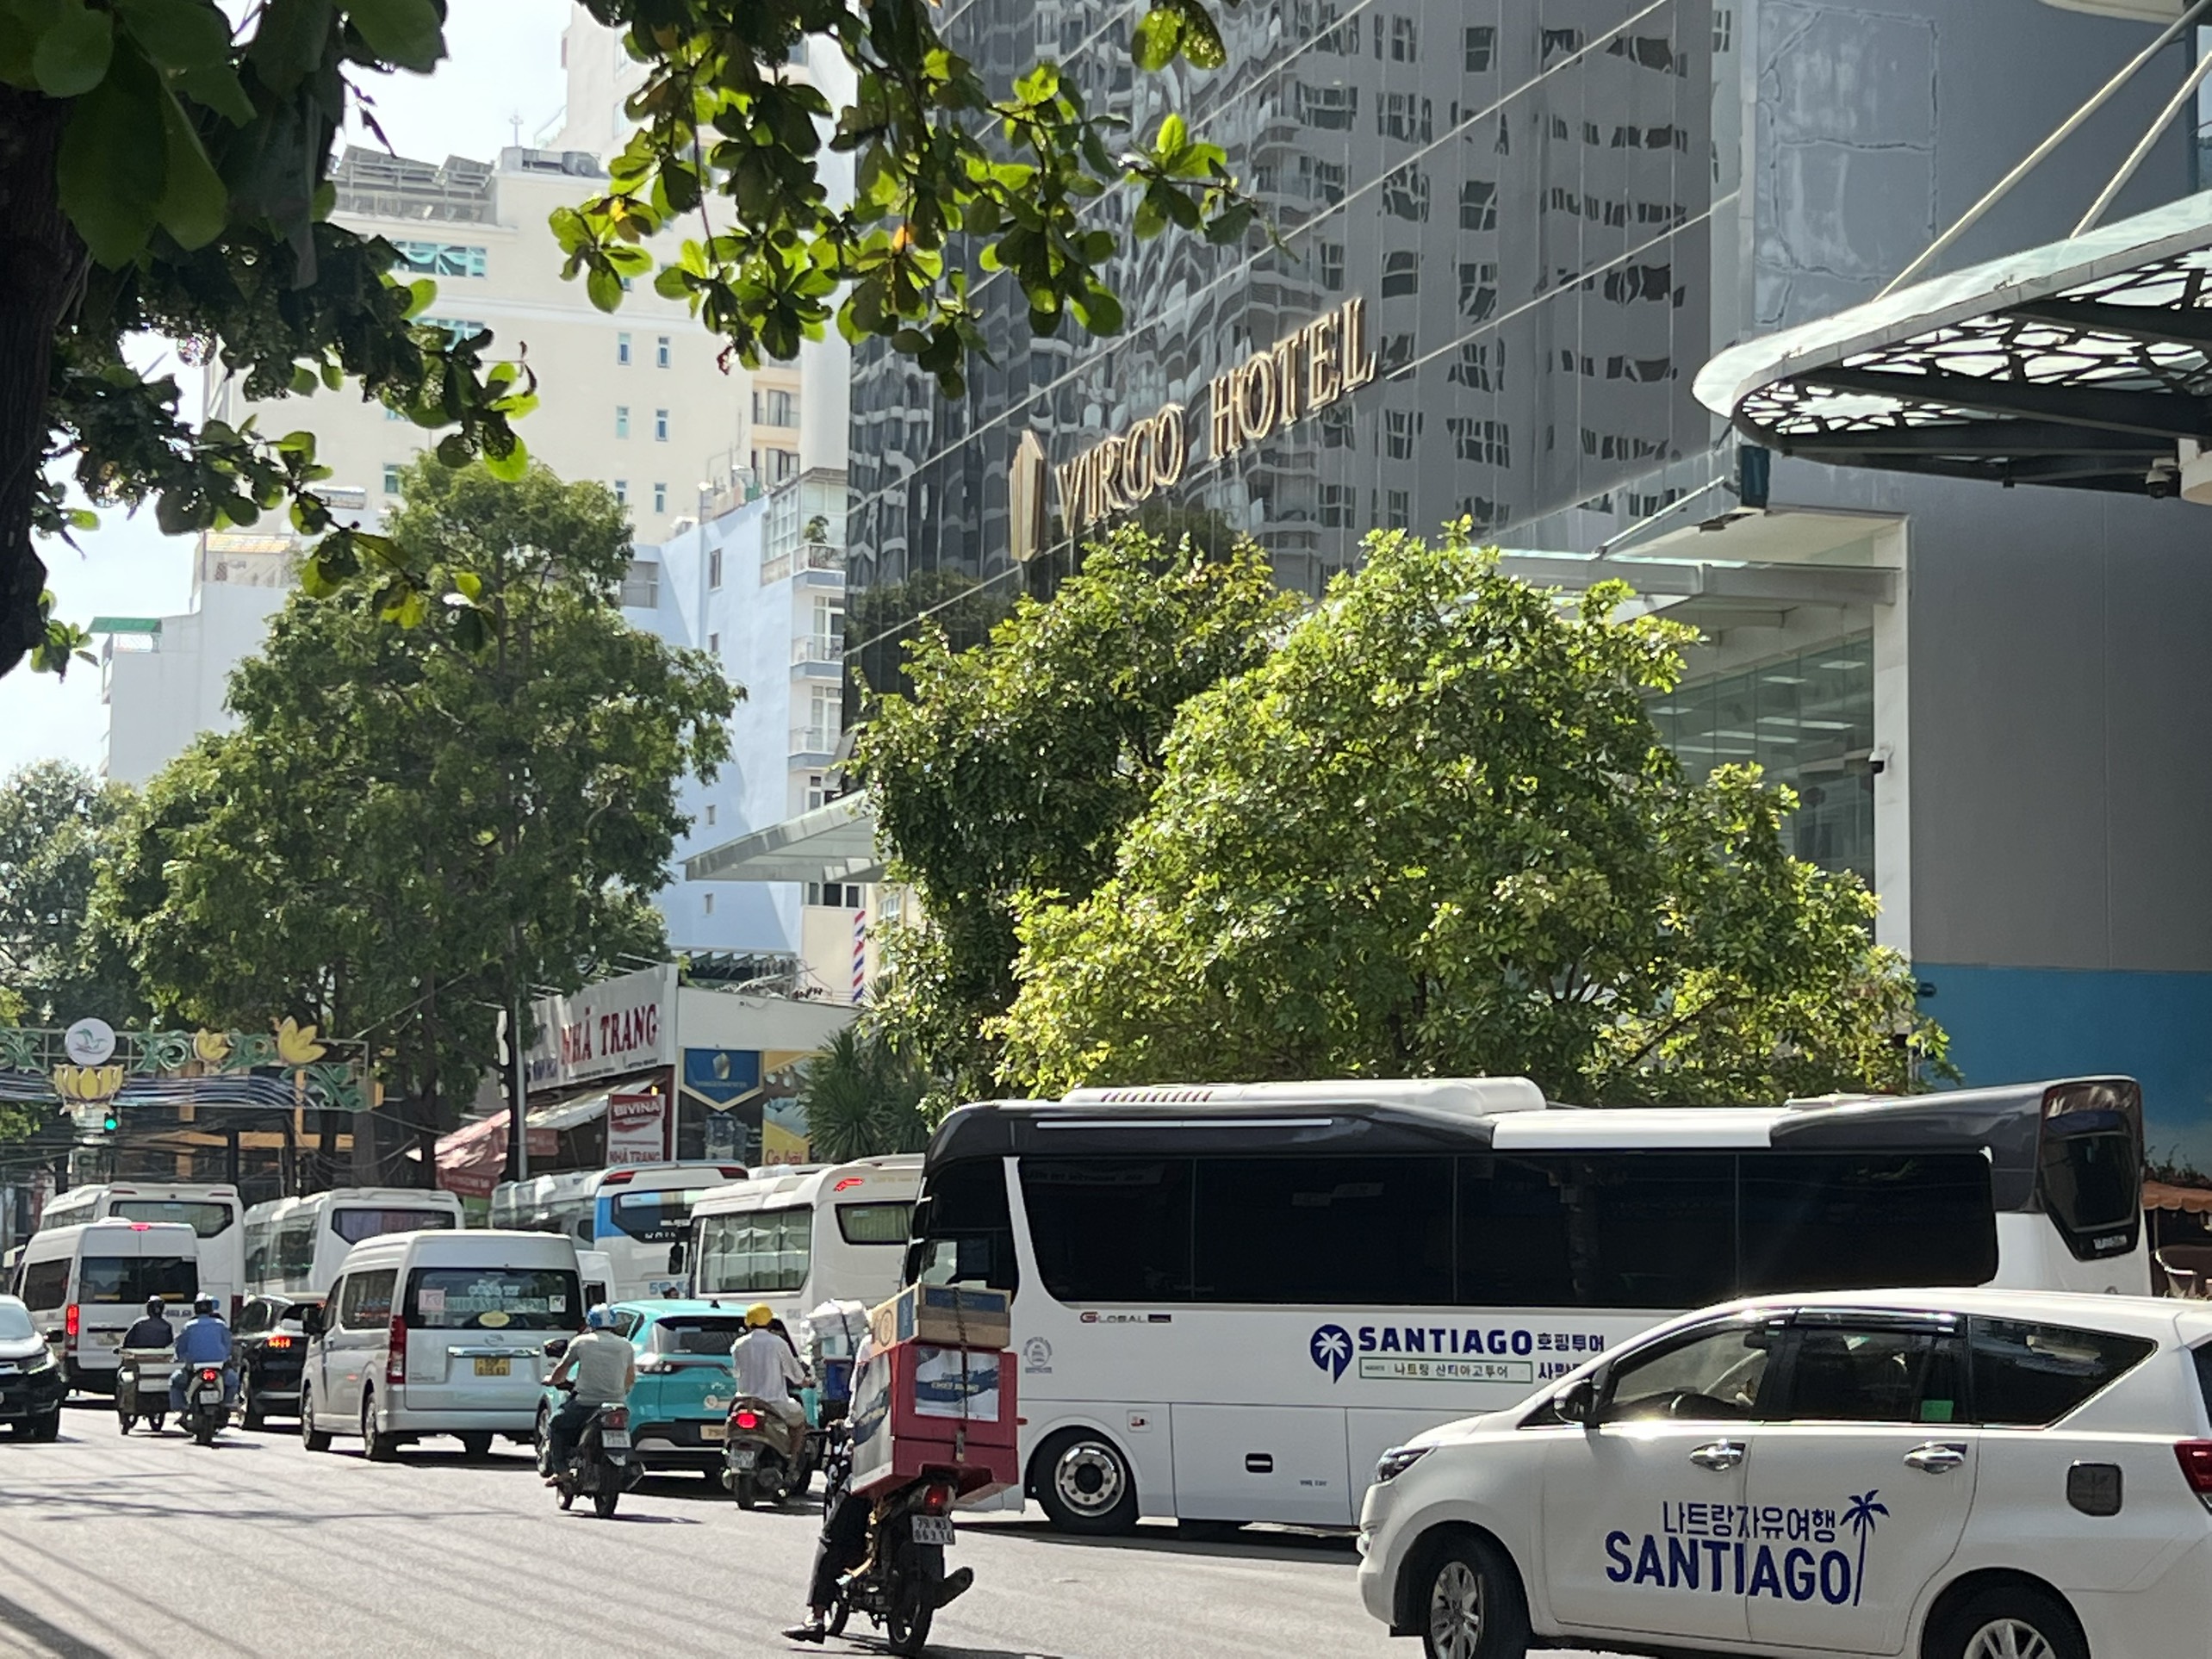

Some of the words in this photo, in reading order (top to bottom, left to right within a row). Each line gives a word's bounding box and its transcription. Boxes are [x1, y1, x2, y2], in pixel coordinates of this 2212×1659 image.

[1209, 295, 1376, 460] HOTEL
[600, 1003, 659, 1056] TRANG
[1358, 1326, 1533, 1356] SANTIAGO
[1662, 1501, 1836, 1543] 나트랑자유여행
[1605, 1530, 1851, 1606] SANTIAGO
